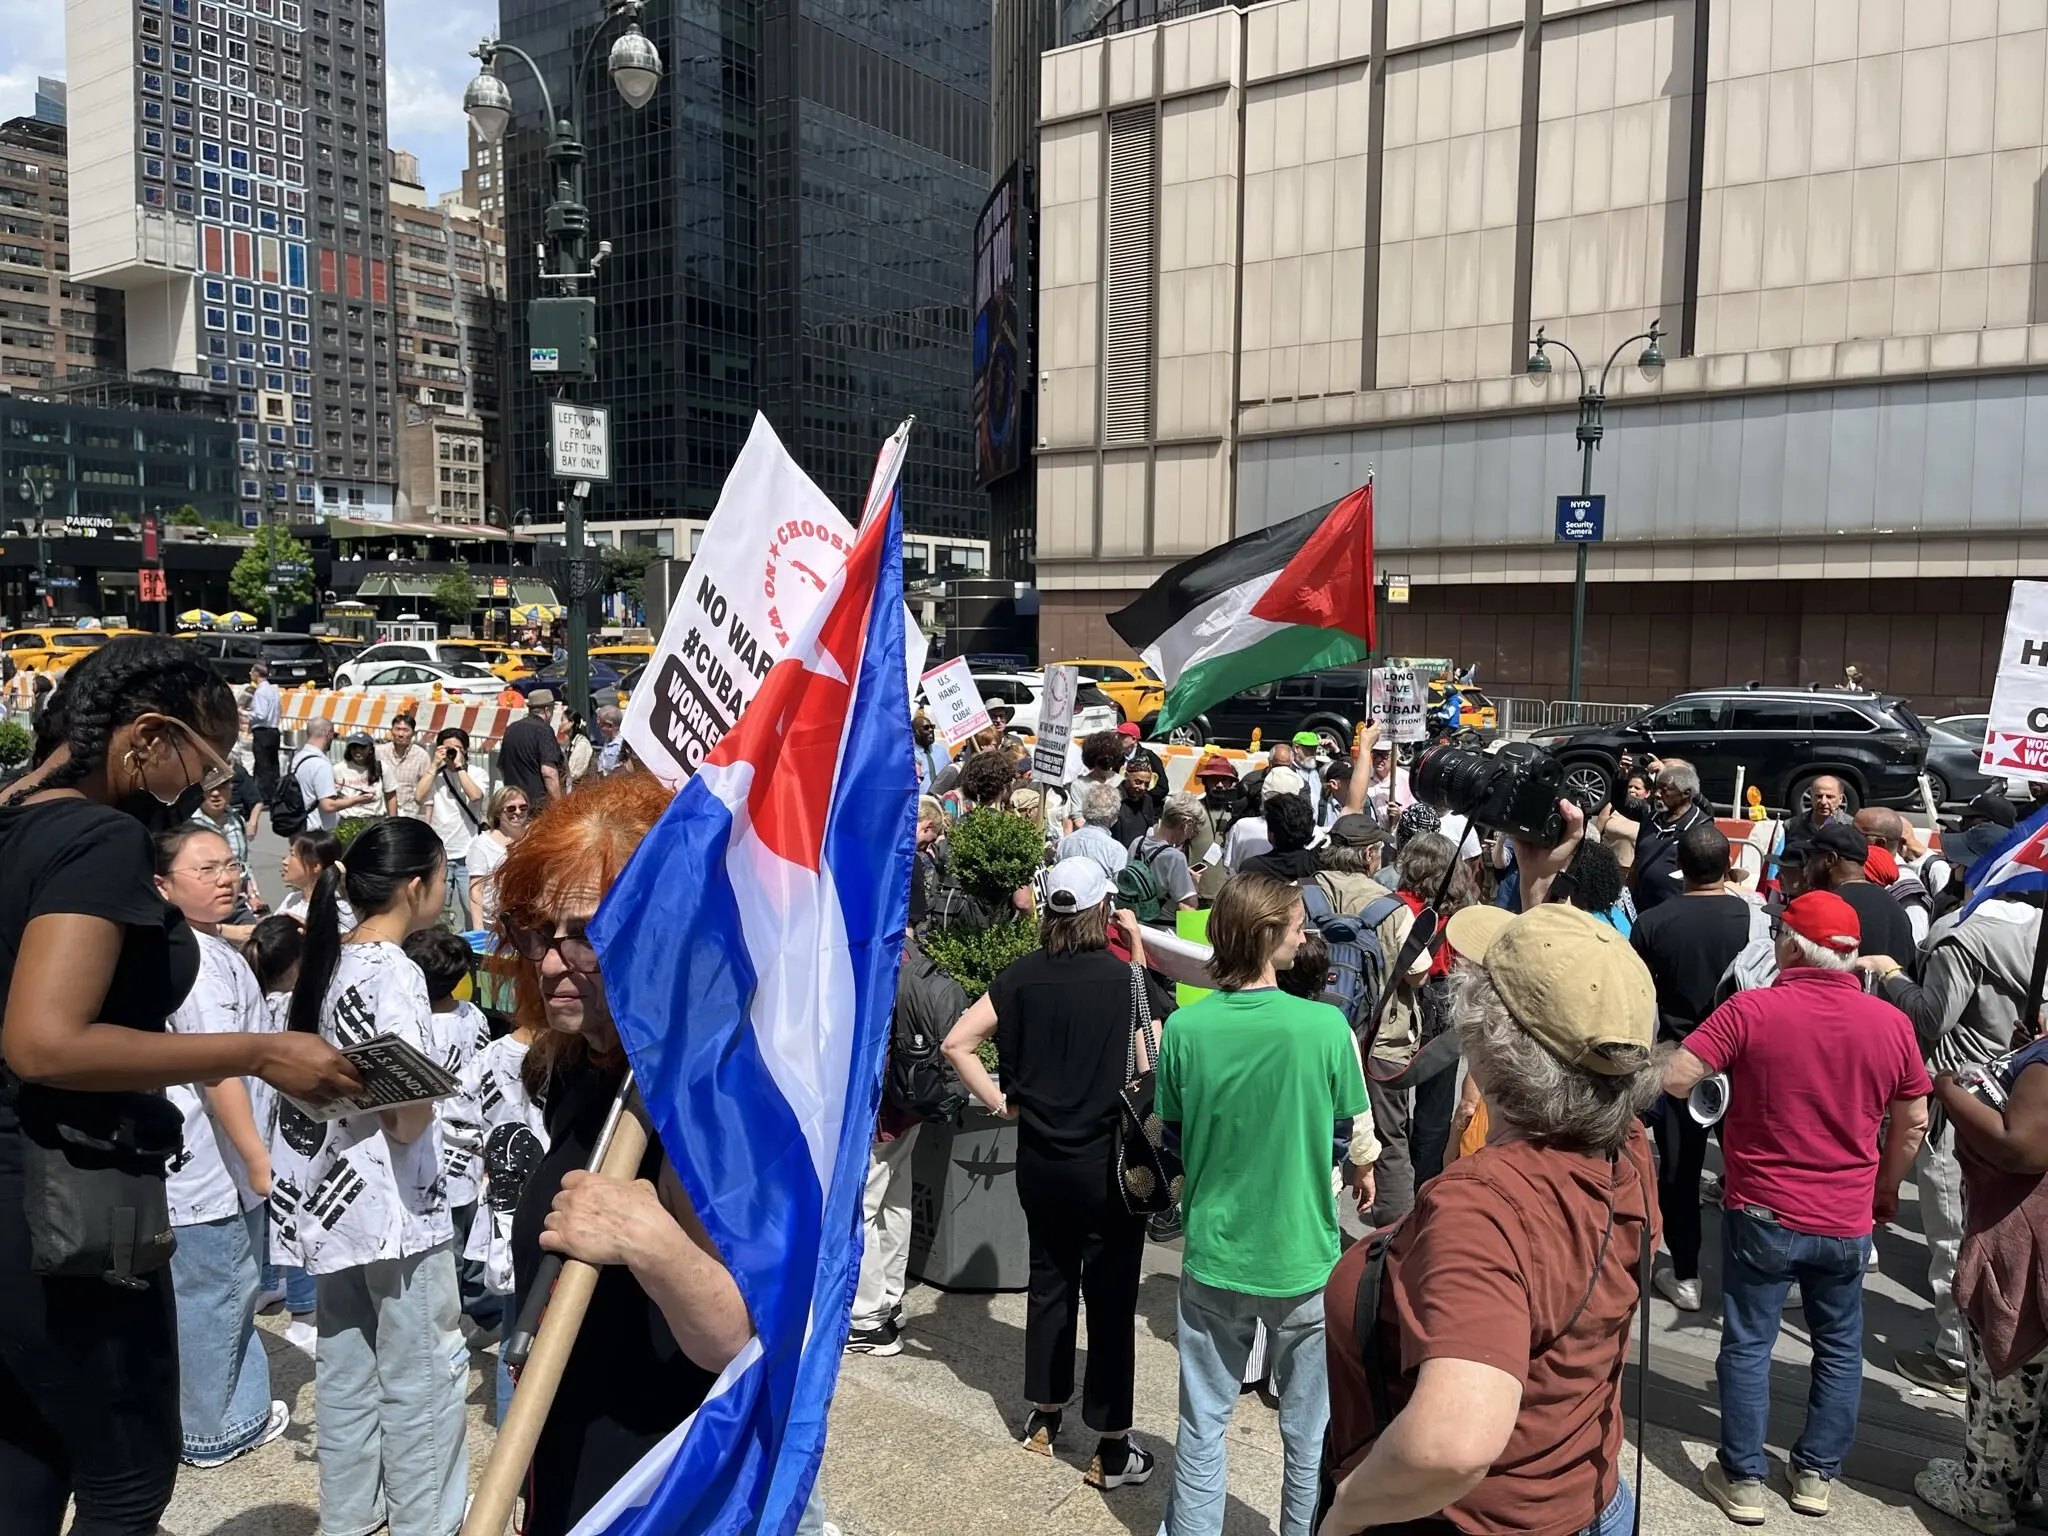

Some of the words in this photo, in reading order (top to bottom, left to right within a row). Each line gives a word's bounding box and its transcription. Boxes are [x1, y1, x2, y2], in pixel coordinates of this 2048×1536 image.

[531, 349, 557, 360] NYC
[558, 412, 577, 425] LEFT
[581, 415, 601, 428] TURN
[570, 428, 591, 440] FROM
[560, 441, 579, 453] LEFT
[582, 444, 602, 456] TURN
[561, 456, 577, 467] BAY
[581, 458, 600, 469] ONLY
[66, 516, 113, 528] PARKING
[1565, 521, 1594, 529] Security
[144, 573, 165, 583] RA
[696, 574, 727, 628] NO
[727, 613, 774, 681] WAR
[768, 605, 790, 649] WA
[937, 674, 951, 686] U.S.
[1384, 672, 1414, 681] LONG
[938, 683, 961, 701] HANDS
[1386, 684, 1410, 693] LIVE
[667, 670, 725, 751] WORKE
[951, 699, 964, 711] OFF
[1372, 704, 1421, 715] CUBAN
[952, 707, 972, 723] CUBA!
[667, 712, 705, 766] WO
[346, 1053, 375, 1070] OFF
[386, 1063, 428, 1097] HANDS
